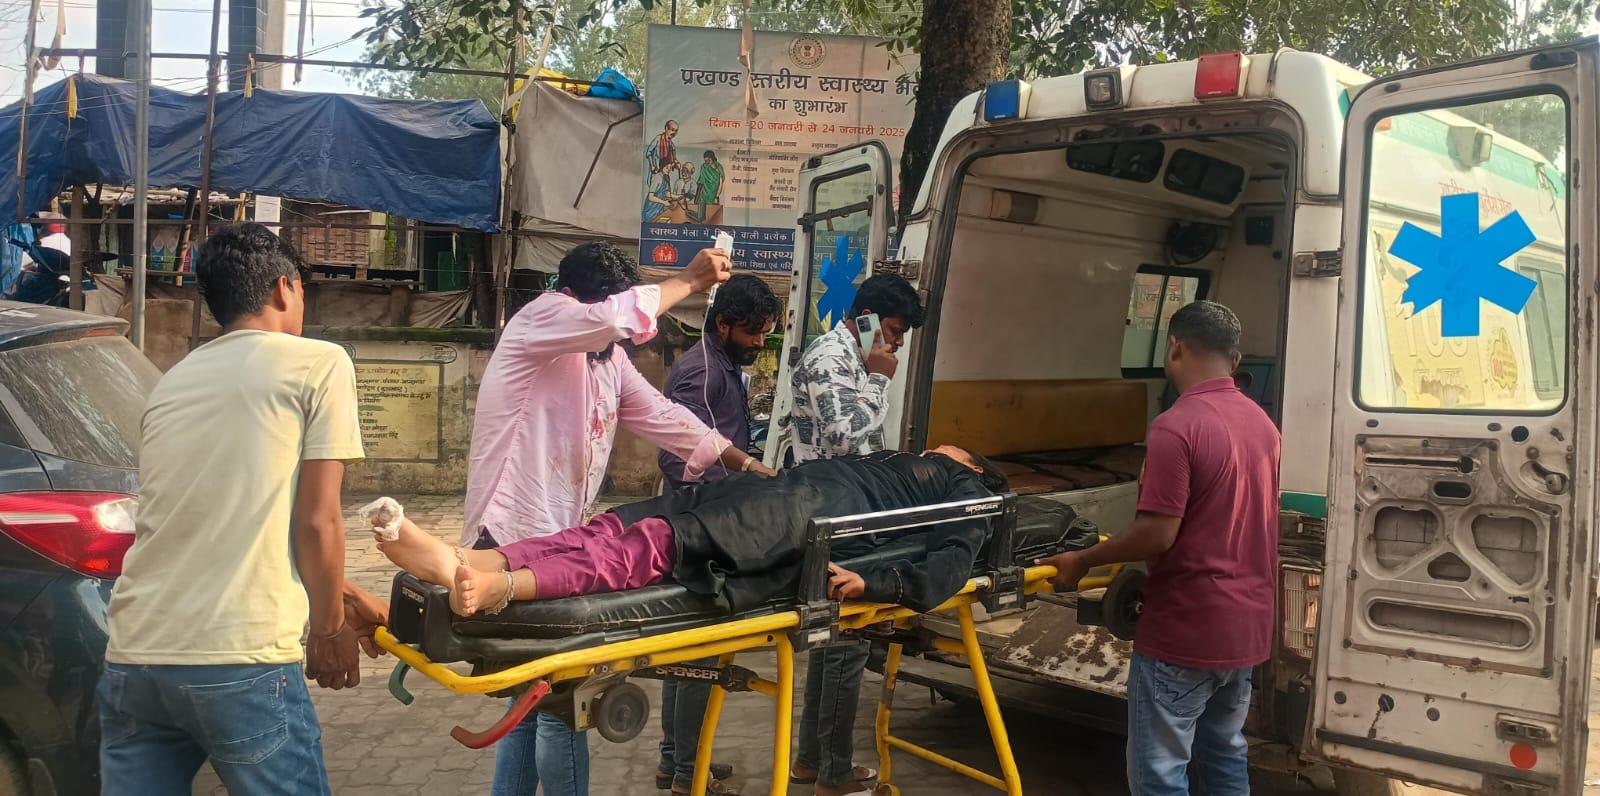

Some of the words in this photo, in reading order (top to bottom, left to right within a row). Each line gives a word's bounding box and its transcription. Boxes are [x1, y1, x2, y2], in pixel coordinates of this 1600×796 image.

[680, 69, 742, 87] प्रखण्ड
[750, 67, 811, 90] स्तरीय
[817, 76, 888, 94] स्वास्थ्य
[768, 98, 788, 110] का
[793, 96, 848, 117] शुभारंभ
[768, 120, 802, 132] जनवरी
[808, 122, 817, 133] से
[822, 124, 835, 133] 24
[839, 124, 874, 136] जनवरी
[880, 127, 905, 137] 2025
[649, 227, 678, 236] स्वास्थ्य
[682, 227, 698, 237] मेला
[740, 230, 759, 240] वाली
[763, 231, 787, 241] प्रत्येक
[752, 249, 793, 260] स्वास्थ्य
[749, 260, 766, 269] शिक्षा
[965, 502, 999, 513] SPENCER
[402, 586, 424, 604] SPENCER
[656, 666, 719, 680] SPENCER
